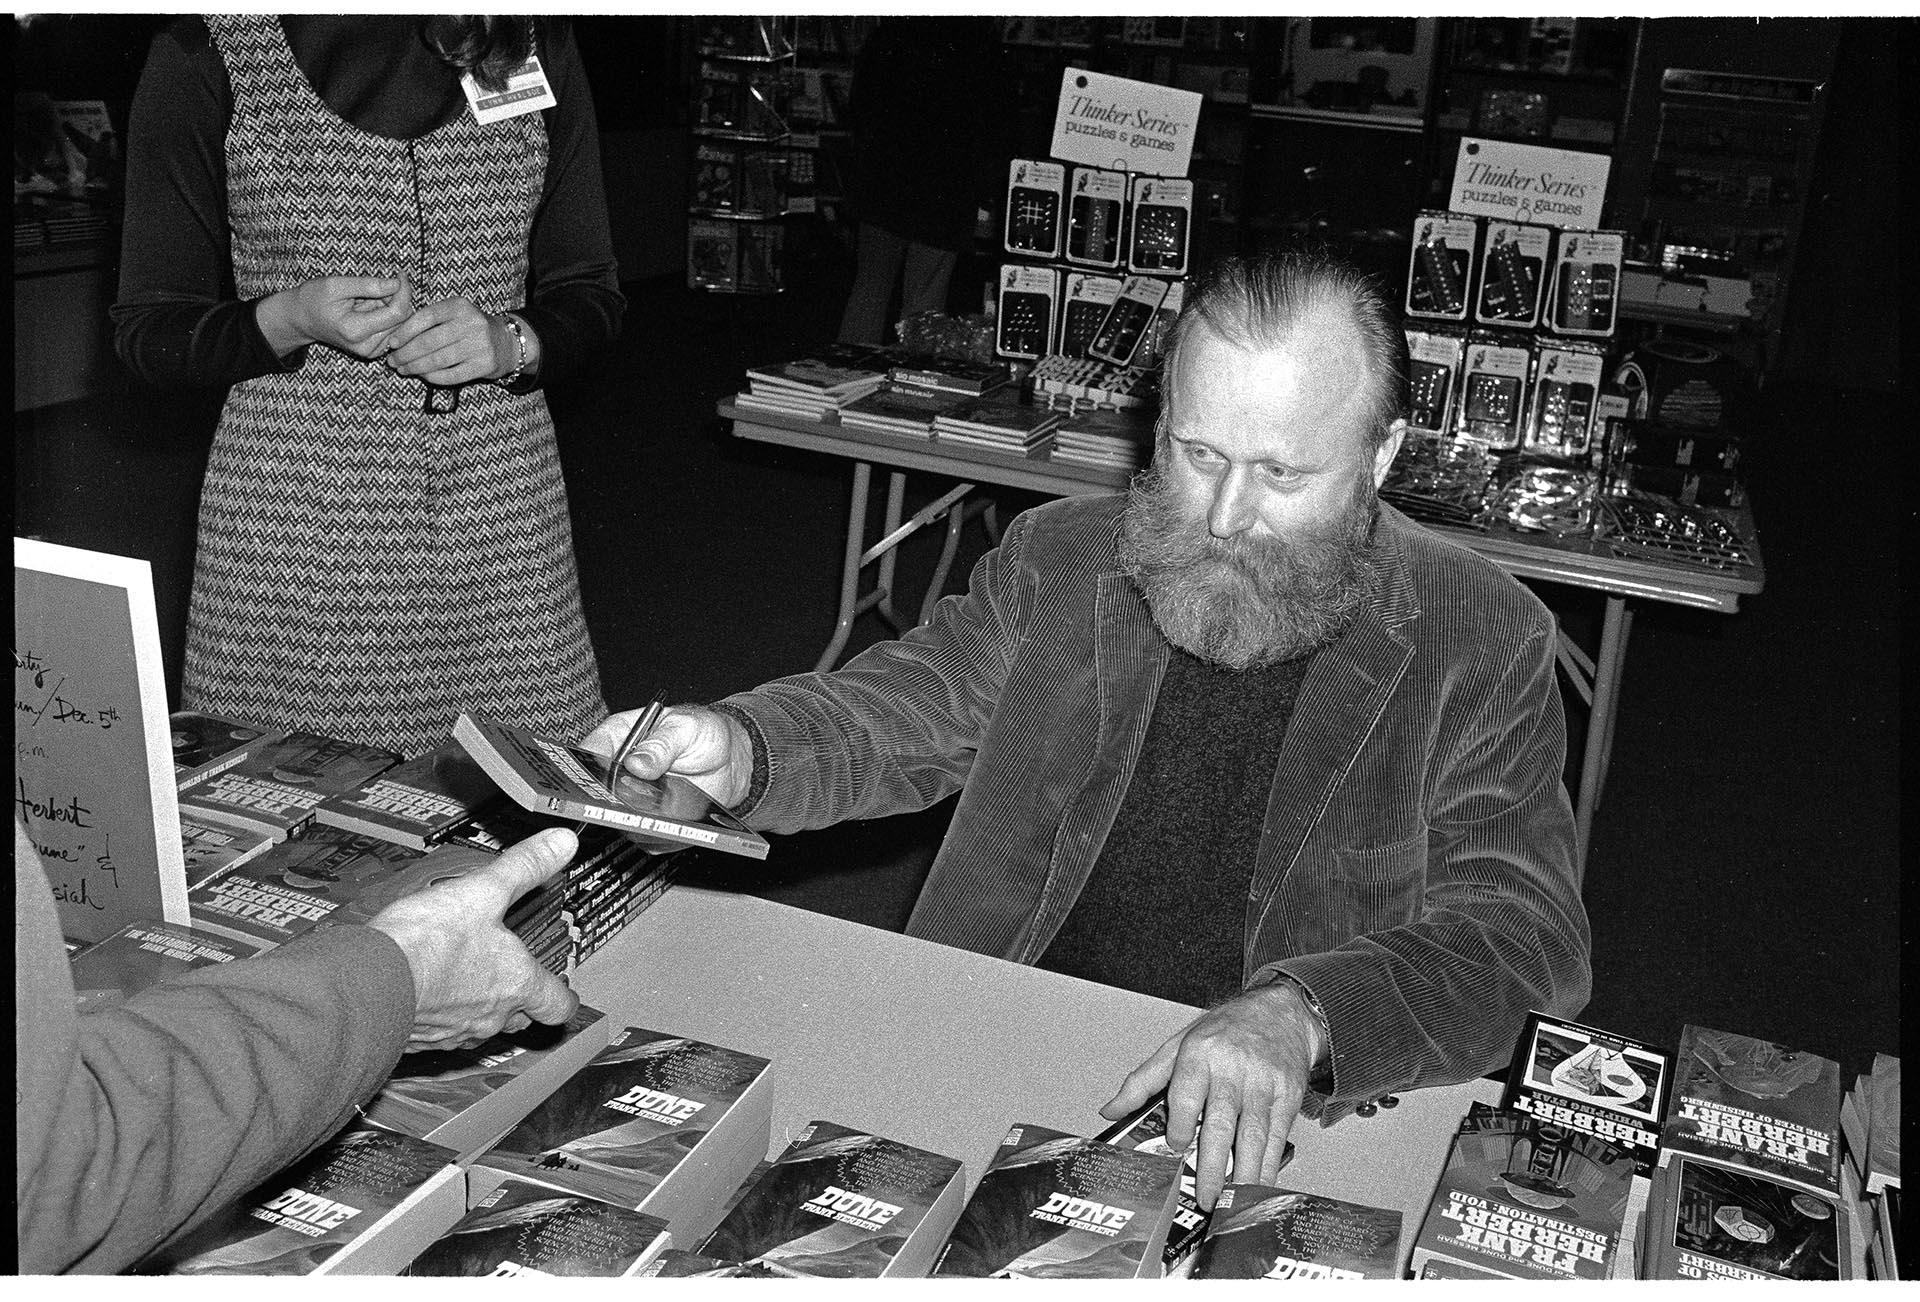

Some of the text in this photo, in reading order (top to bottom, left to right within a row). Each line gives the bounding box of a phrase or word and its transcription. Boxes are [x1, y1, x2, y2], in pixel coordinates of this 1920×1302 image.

[1070, 95, 1179, 136] Thinker Series
[1065, 121, 1116, 140] puzzles
[1130, 134, 1175, 152] games
[1467, 162, 1588, 198] Thinker Series
[1461, 189, 1518, 207] puzzles
[1533, 199, 1582, 216] games
[207, 778, 320, 810] HERBERT
[207, 788, 291, 814] FRANK
[357, 794, 437, 821] FRANK
[360, 784, 466, 817] HERBERT
[583, 804, 603, 819] THE
[602, 809, 640, 828] WORLDS
[640, 817, 653, 830] OF
[652, 819, 681, 836] FRANK
[680, 825, 719, 844] HERBERT
[52, 878, 104, 910] siah
[203, 894, 298, 927] FRANK
[208, 881, 331, 922] HERBERT
[124, 929, 146, 939] THE
[139, 941, 198, 962] FRANK HERBERT
[602, 1100, 684, 1126] FRANK HERBERT
[613, 1085, 706, 1120] DUNE
[1532, 1091, 1644, 1130] WHIPPING STAR
[1680, 1095, 1830, 1141] THE EYES OF HEISENBERG
[1513, 1095, 1659, 1150] HERBERT
[1678, 1104, 1830, 1156] HERBERT
[1696, 1121, 1809, 1164] FRANK
[1762, 1151, 1787, 1164] DUNE
[261, 1187, 363, 1230] DUNE
[799, 1202, 883, 1232] FRANK HERBERT
[808, 1185, 904, 1225] DUNE
[1036, 1191, 1136, 1230] DUNE
[1449, 1191, 1608, 1246] DESTINATION: VOID
[275, 1215, 328, 1238] HERBERT
[1029, 1209, 1120, 1237] FRANK HERBERT
[1441, 1201, 1607, 1265] HERBERT
[1437, 1235, 1480, 1252] MESSIAH
[1456, 1223, 1579, 1274] FRANK
[1481, 1248, 1507, 1260] DUNE
[1526, 1261, 1553, 1276] DUNE
[1677, 1264, 1702, 1279] OF
